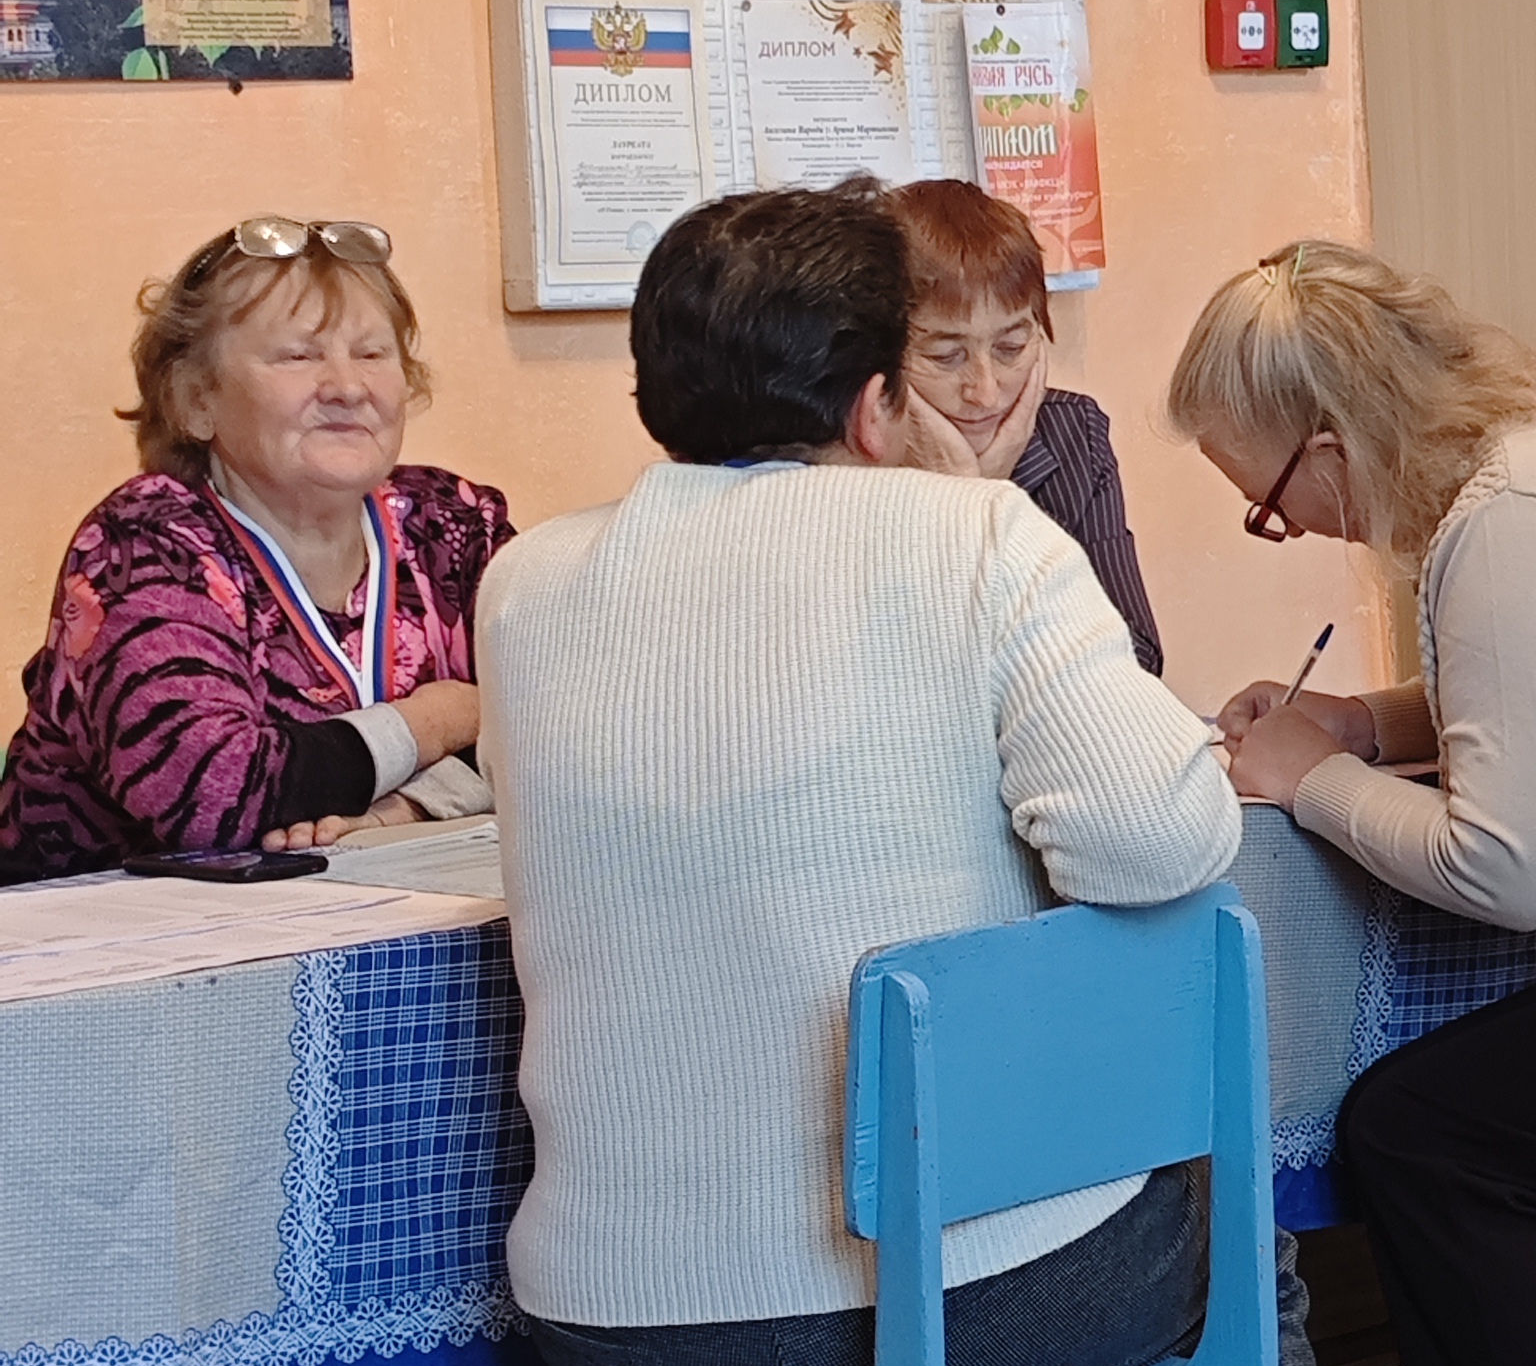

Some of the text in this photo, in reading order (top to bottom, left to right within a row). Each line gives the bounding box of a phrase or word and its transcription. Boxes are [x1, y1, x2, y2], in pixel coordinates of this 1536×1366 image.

[759, 41, 836, 59] ДИПЛОМ
[1014, 64, 1054, 87] РУСЬ
[574, 83, 672, 106] ДИПЛОМ
